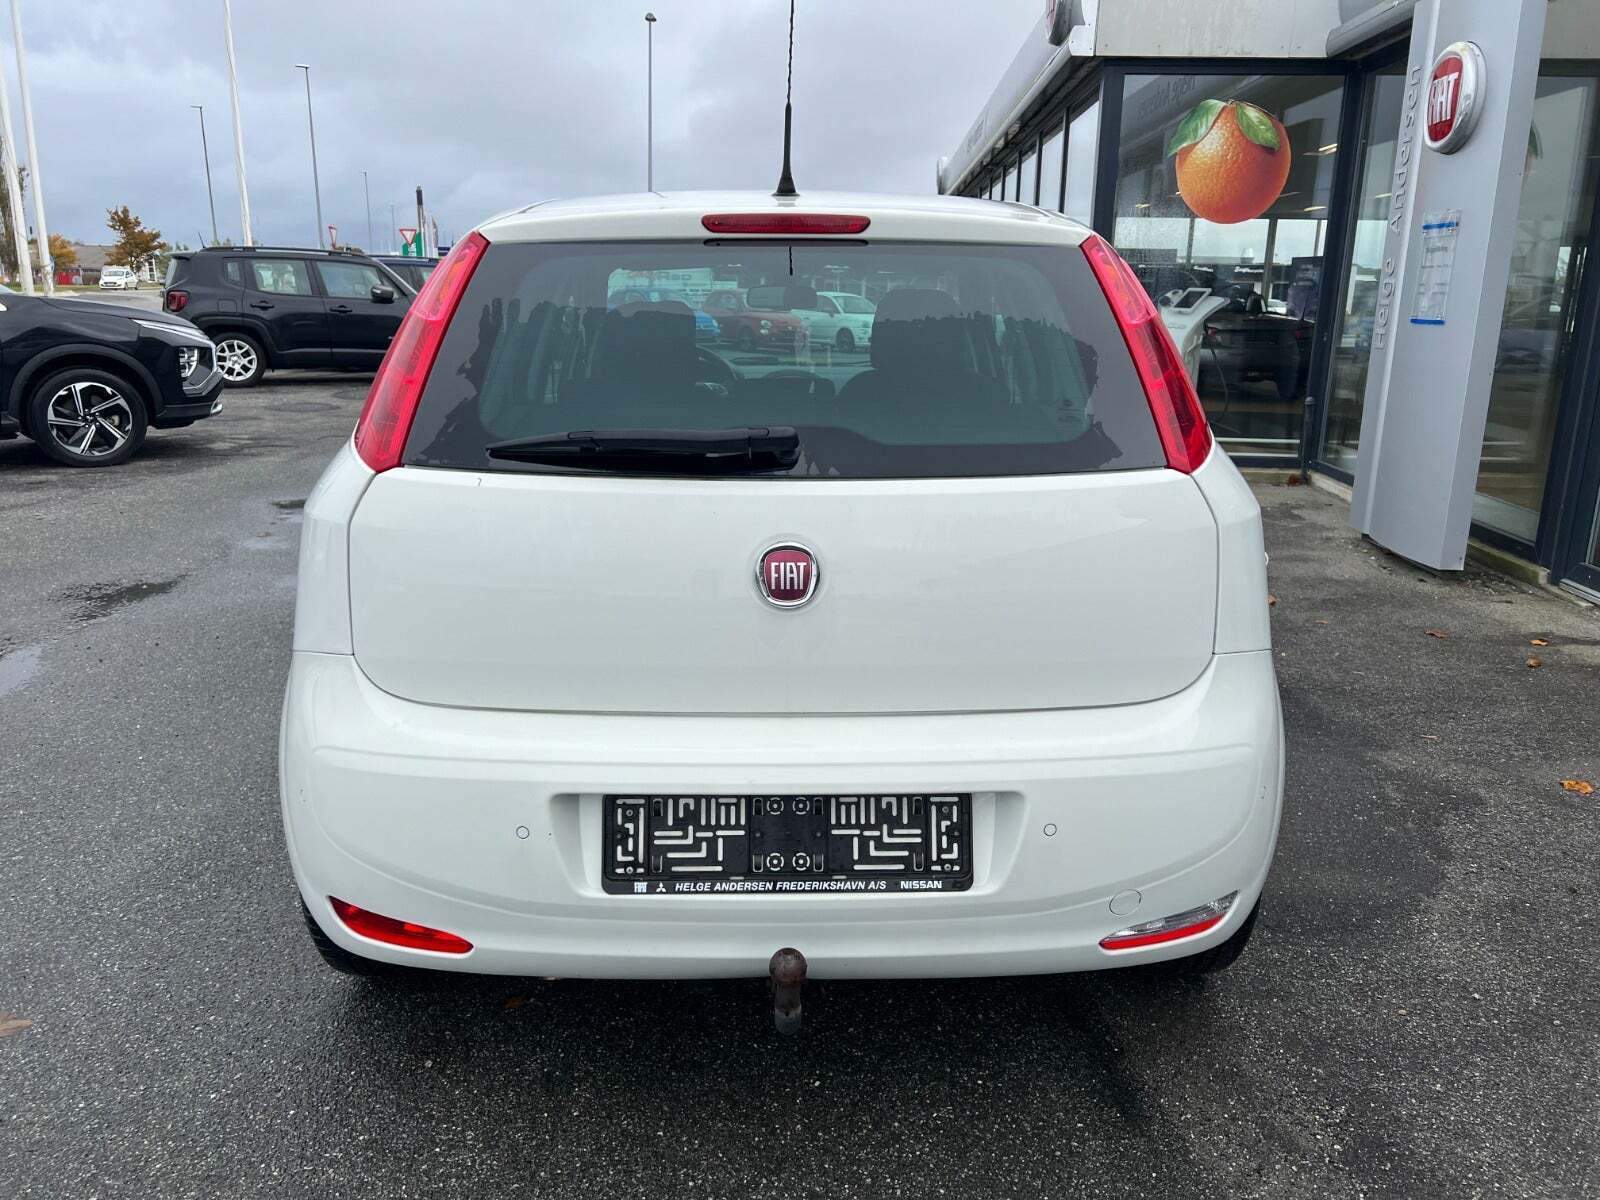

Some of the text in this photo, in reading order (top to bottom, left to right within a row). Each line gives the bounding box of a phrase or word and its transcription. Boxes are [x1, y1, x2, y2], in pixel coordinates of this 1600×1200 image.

[1428, 71, 1460, 126] FIAT
[1374, 66, 1423, 350] Helge Andersen
[770, 561, 808, 590] FIAT
[675, 880, 887, 892] HELGE ANDERSEN FREDERIKSHAVN A/S
[900, 880, 942, 889] NISSAN
